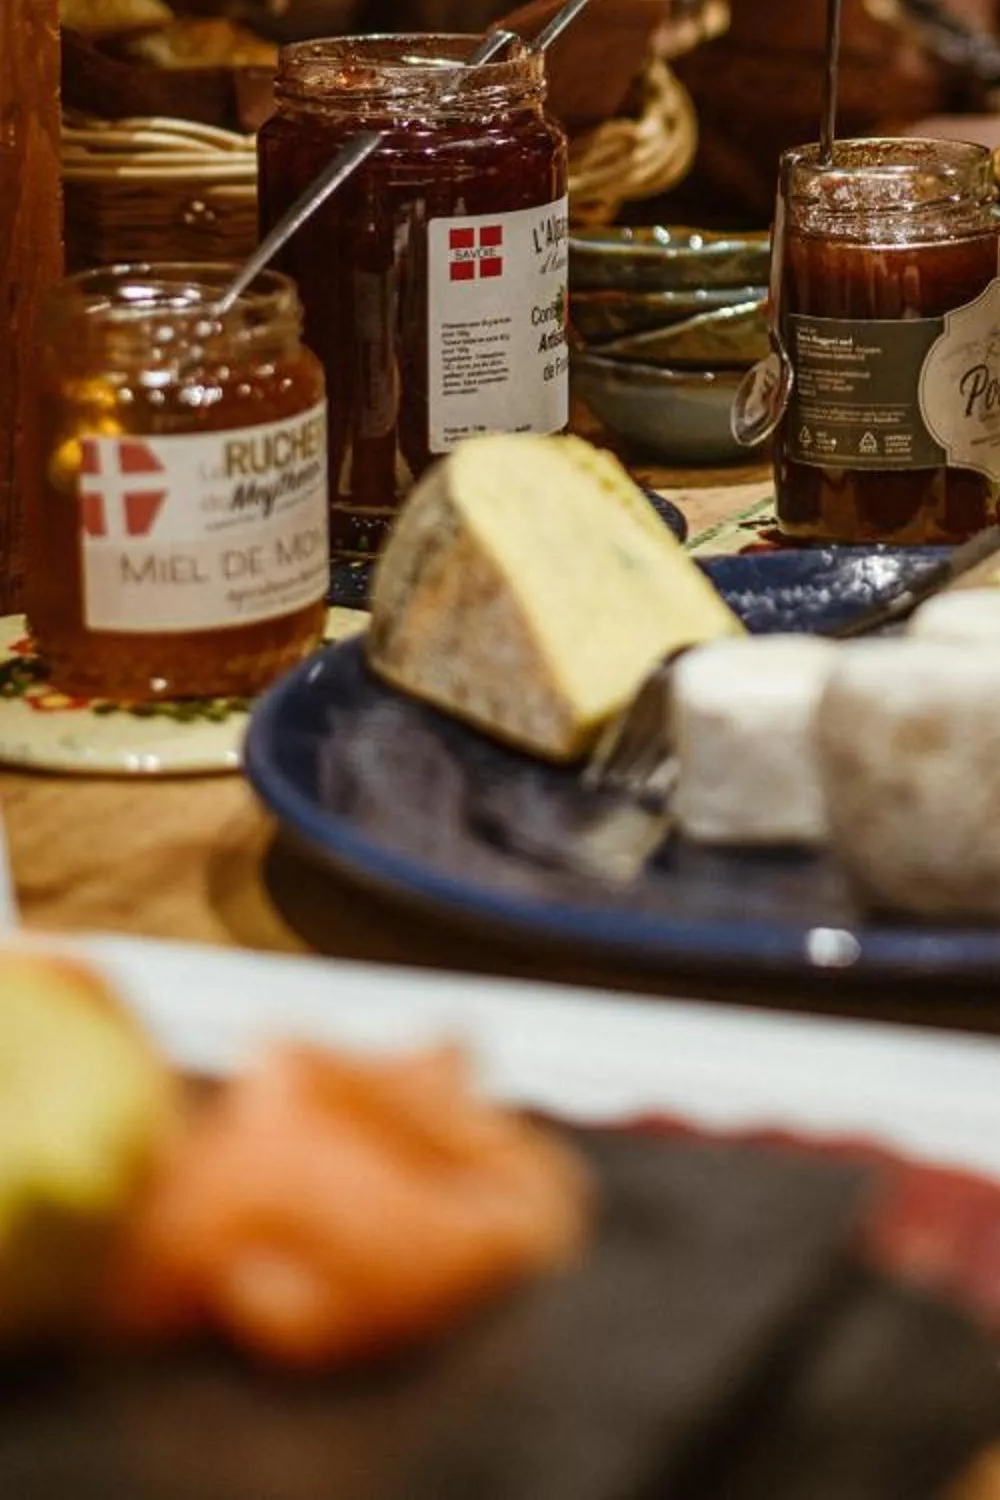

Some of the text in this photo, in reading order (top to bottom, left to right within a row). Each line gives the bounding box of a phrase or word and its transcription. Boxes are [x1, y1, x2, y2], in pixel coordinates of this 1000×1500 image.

[455, 248, 497, 260] SAVOIE
[225, 414, 325, 477] RUCHE
[120, 551, 210, 587] MIEL
[221, 546, 264, 582] DE
